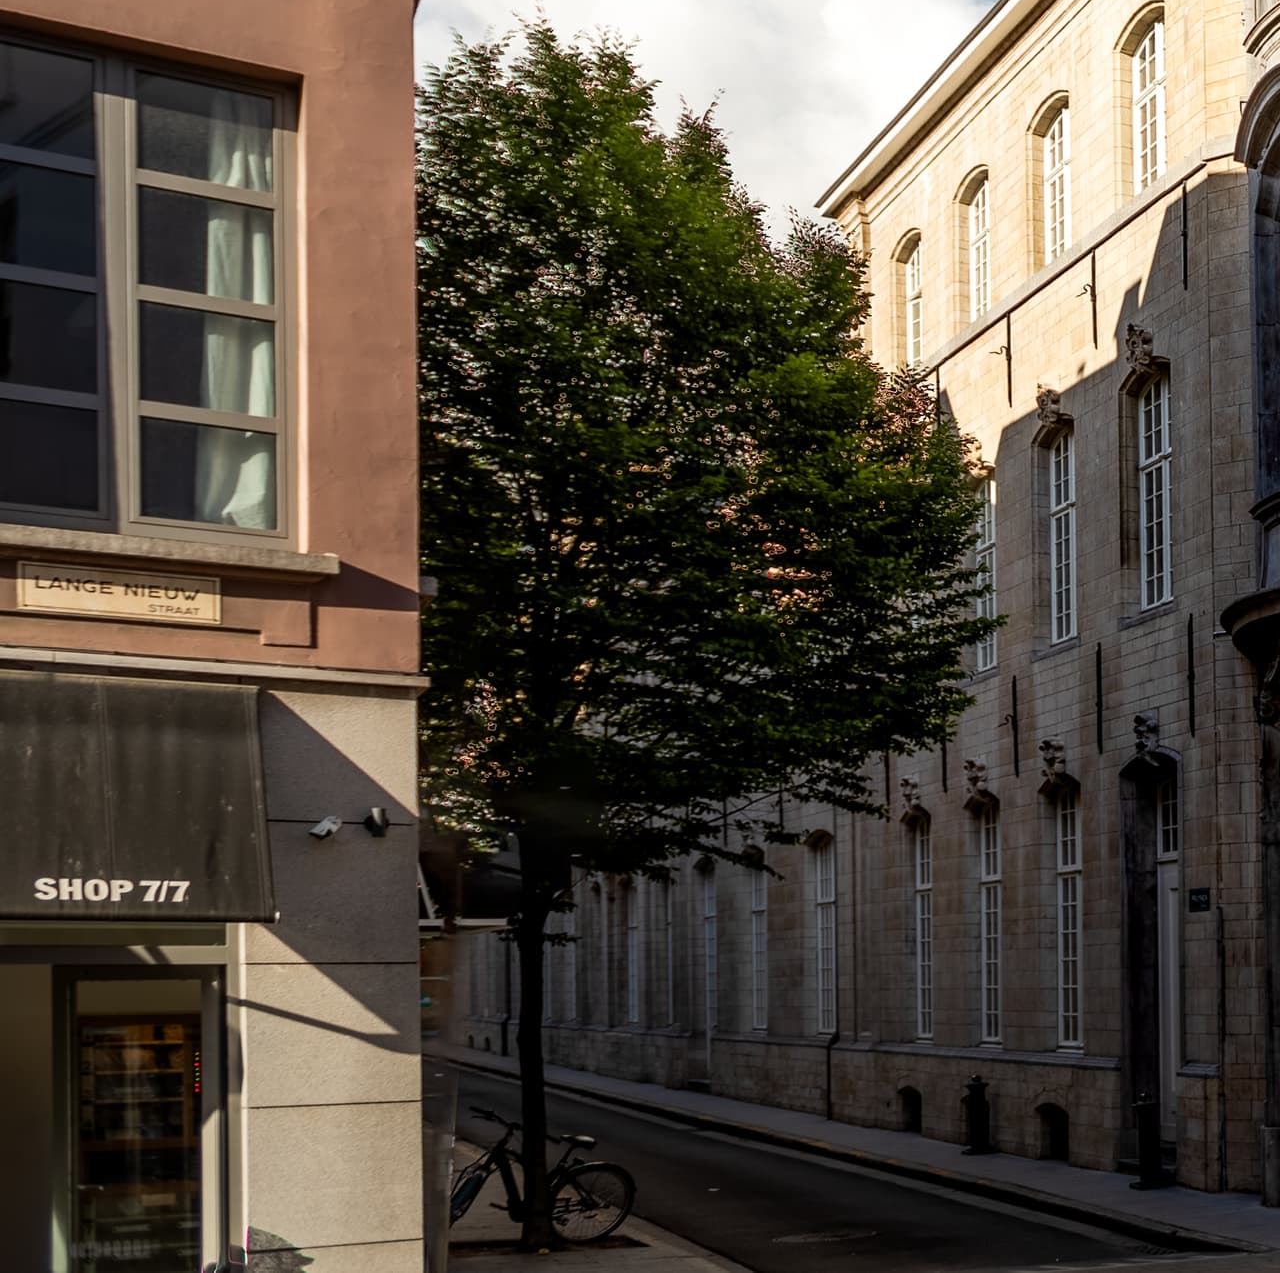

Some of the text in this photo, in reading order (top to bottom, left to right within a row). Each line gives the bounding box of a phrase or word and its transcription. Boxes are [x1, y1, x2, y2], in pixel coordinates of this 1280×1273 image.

[34, 575, 201, 602] LANGE NIEUW
[148, 603, 201, 616] STRAAT
[34, 877, 191, 903] SHOP 7/7
